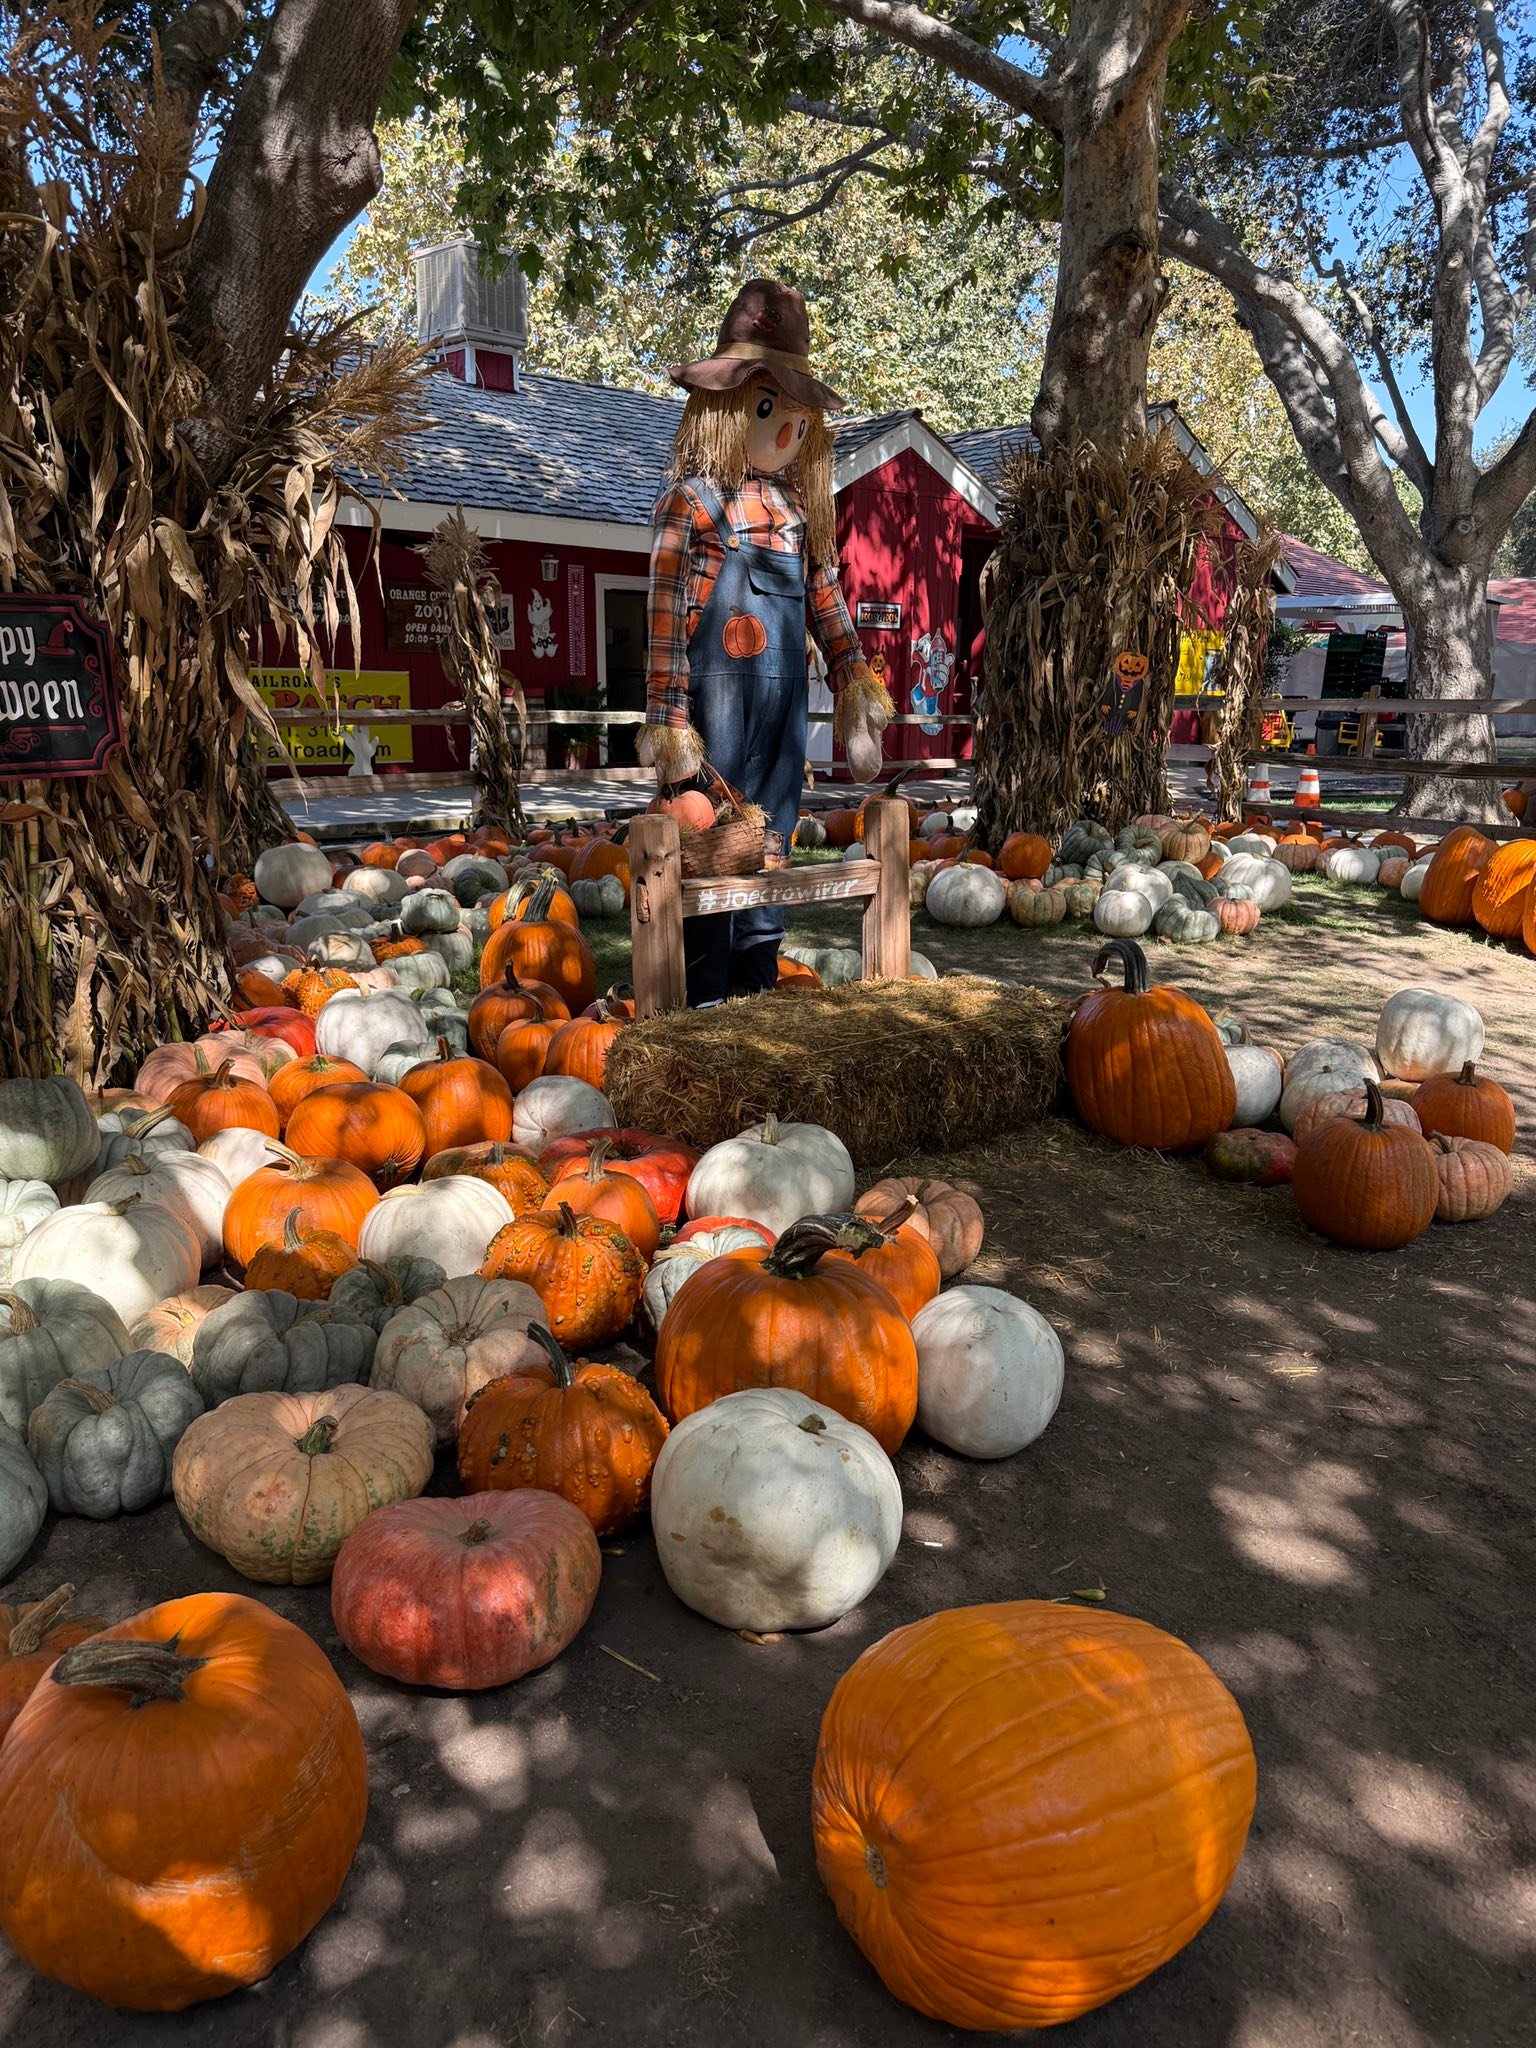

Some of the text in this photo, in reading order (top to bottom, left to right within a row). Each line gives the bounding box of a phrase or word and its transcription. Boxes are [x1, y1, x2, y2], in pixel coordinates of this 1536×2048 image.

[389, 589, 427, 601] ORANGE
[414, 605, 443, 619] ZOO
[405, 623, 427, 633] OPEN
[537, 636, 554, 649] BOO
